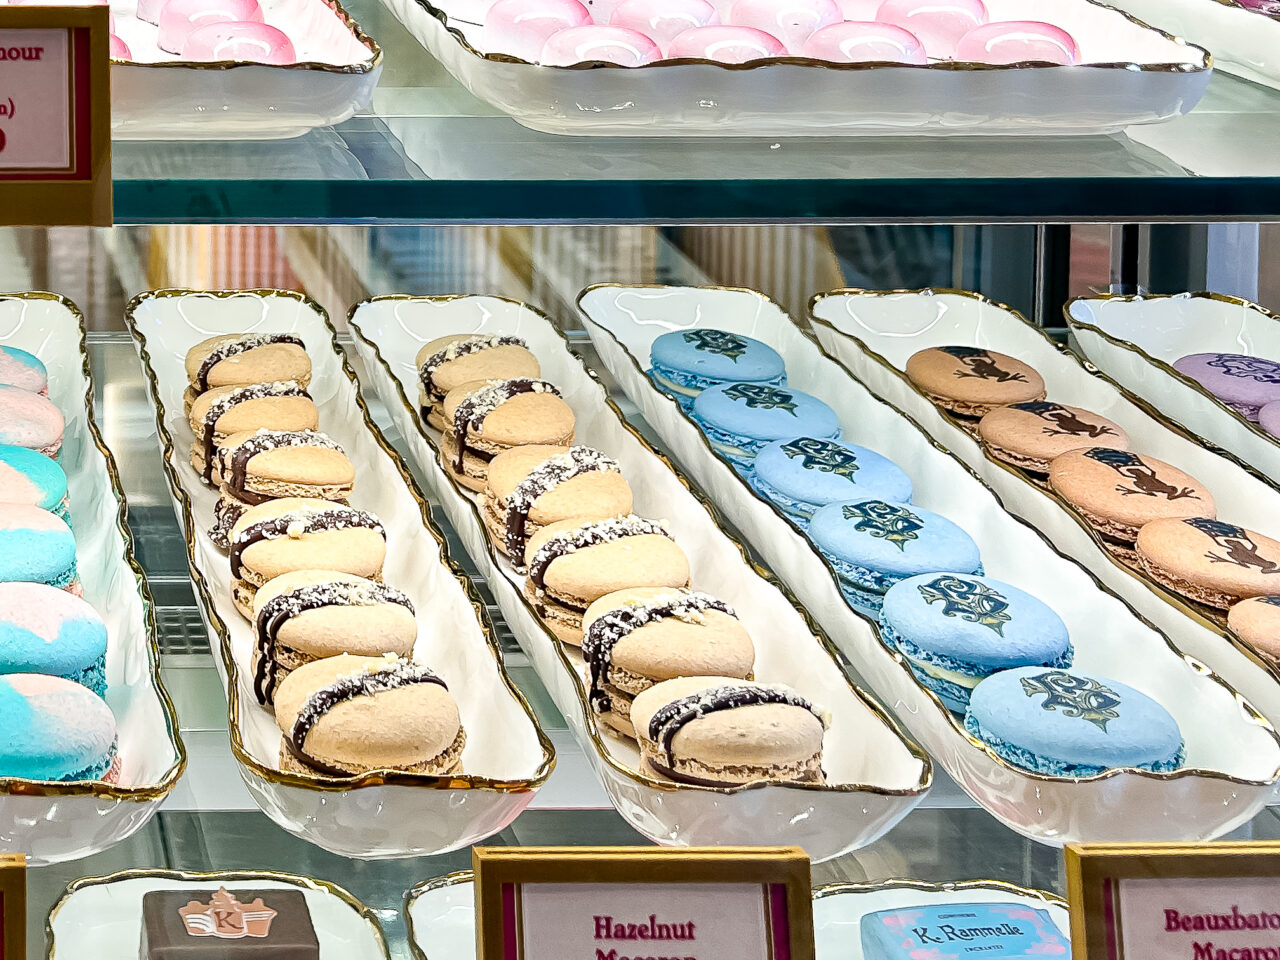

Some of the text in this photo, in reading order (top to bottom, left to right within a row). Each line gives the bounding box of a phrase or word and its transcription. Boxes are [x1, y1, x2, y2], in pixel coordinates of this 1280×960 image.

[214, 911, 245, 930] K
[592, 913, 696, 941] Hazelnut
[937, 923, 1025, 942] Rammelle
[1192, 941, 1280, 960] Macaro
